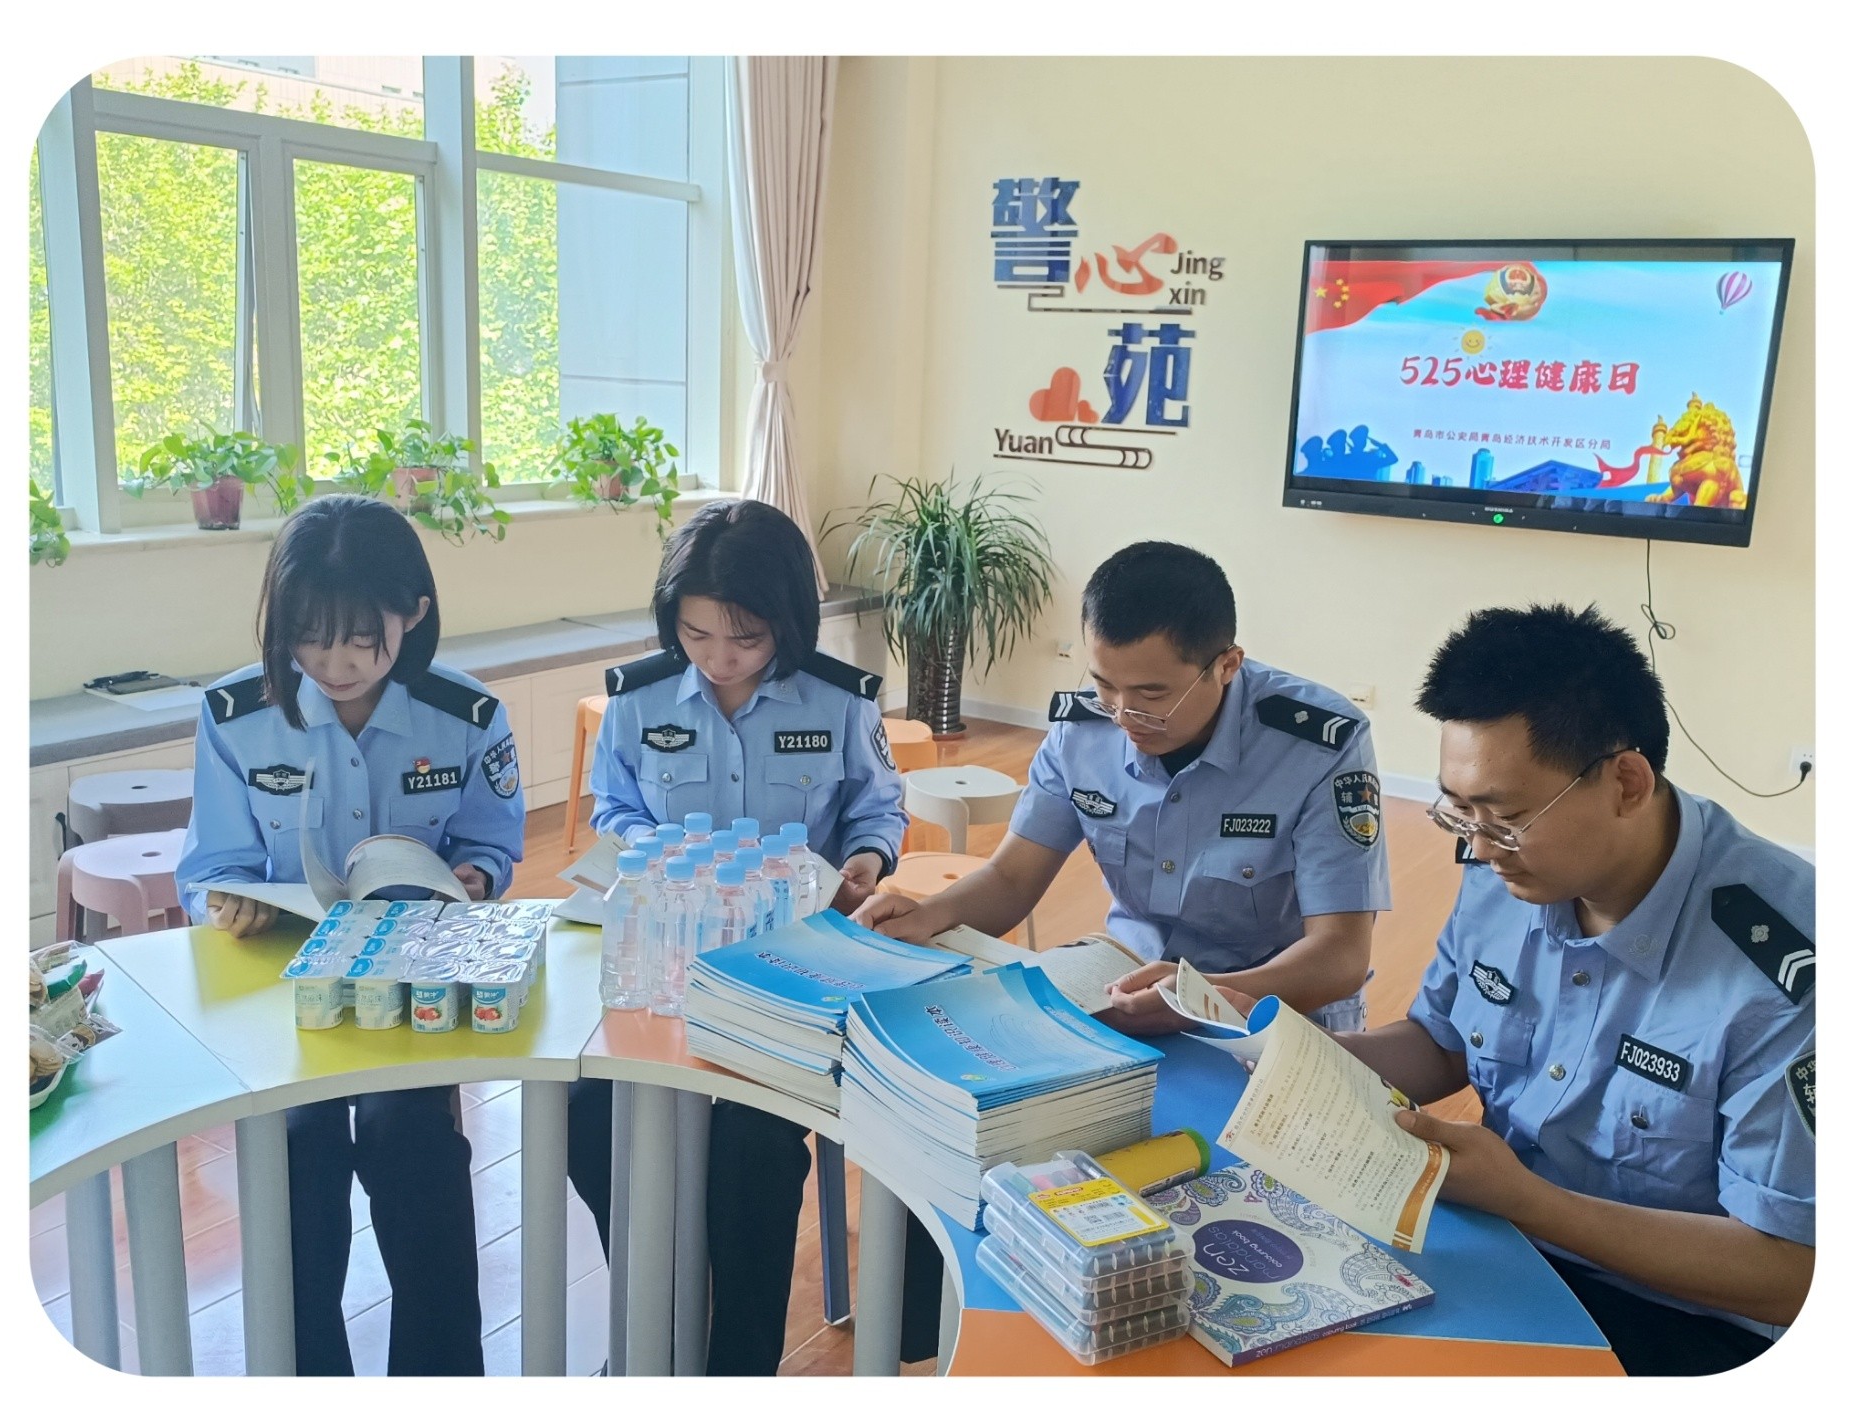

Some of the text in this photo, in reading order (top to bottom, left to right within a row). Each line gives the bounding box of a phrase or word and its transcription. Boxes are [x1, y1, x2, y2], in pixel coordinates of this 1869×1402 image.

[991, 177, 1178, 296] 警 心
[1170, 250, 1225, 281] Jing
[1169, 281, 1207, 306] xin
[1101, 322, 1197, 428] 苑
[1399, 355, 1641, 396] 525心理健康日
[994, 428, 1053, 455] Yuan
[1412, 429, 1611, 450] 青岛市公安局青岛经济技术开发区分局
[778, 735, 828, 749] Y21180
[407, 773, 458, 790] Y21181
[1223, 818, 1271, 834] FJ023222
[1620, 1043, 1681, 1083] FJ023933
[1232, 1230, 1250, 1244] book
[1203, 1243, 1249, 1275] zen
[1208, 1227, 1281, 1279] mandalas
[1256, 1346, 1273, 1358] zen
